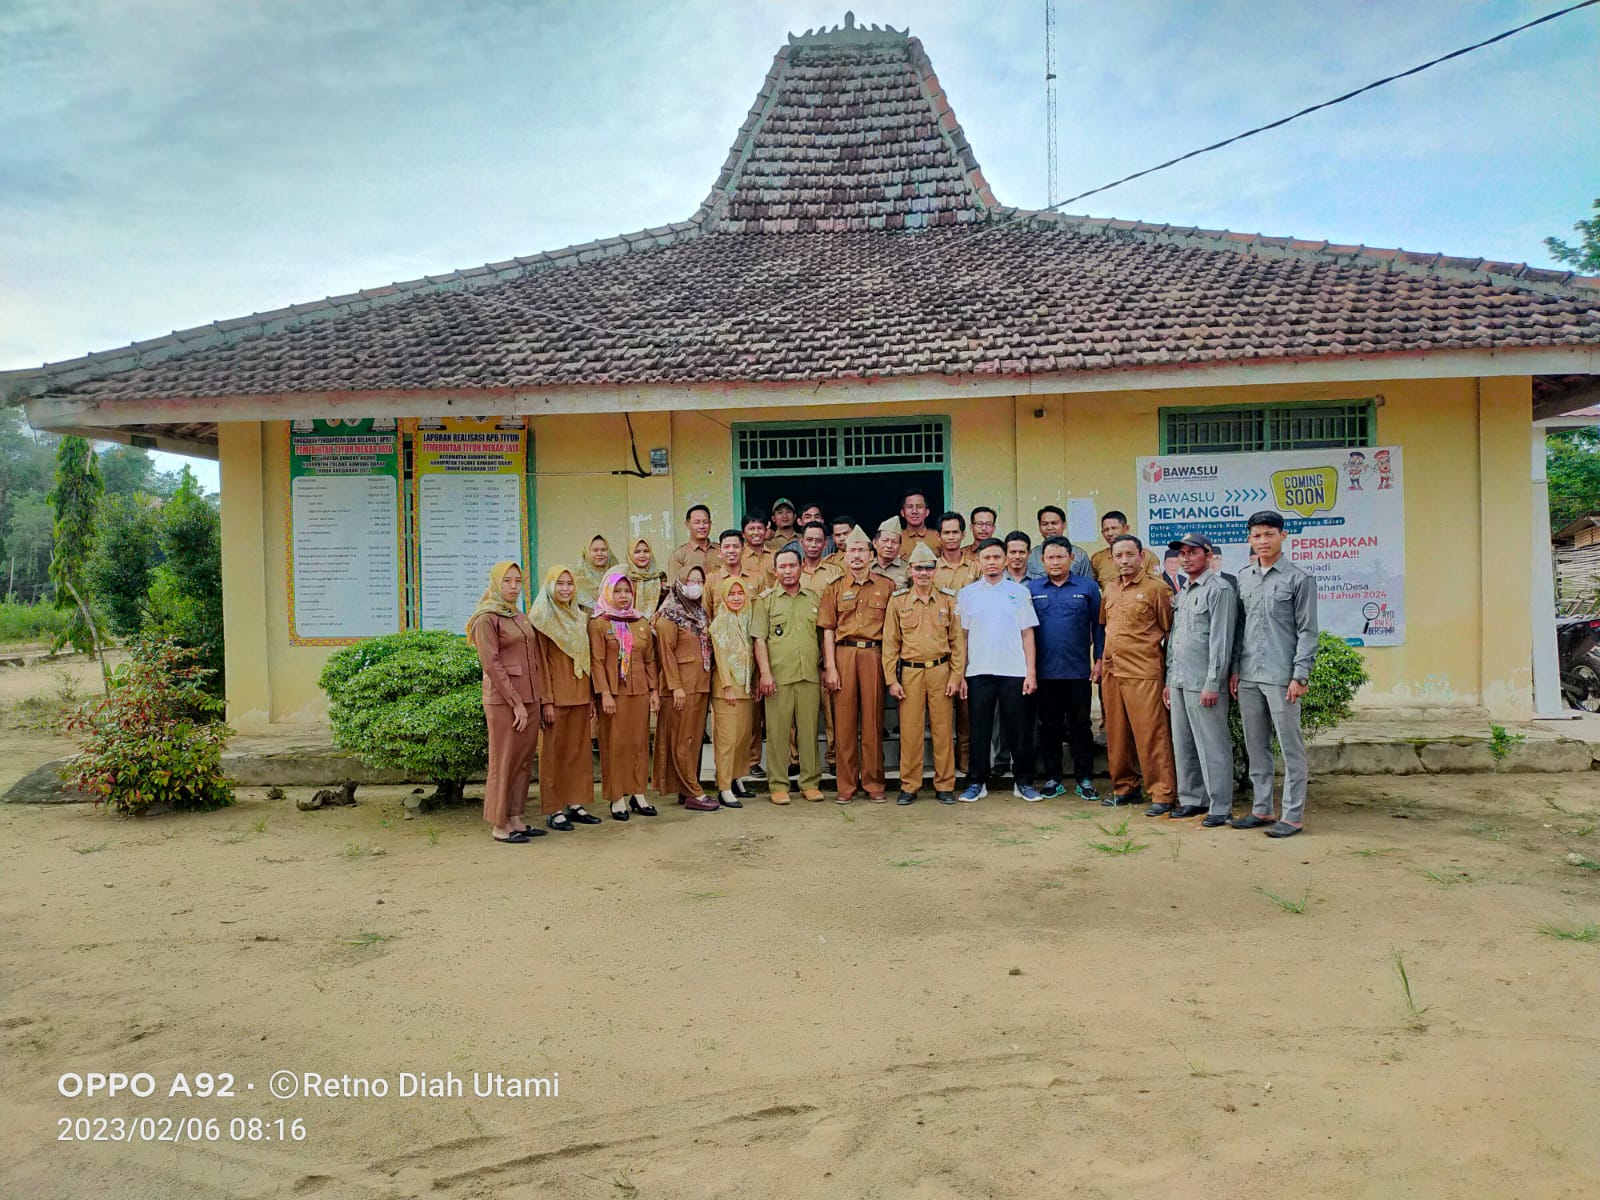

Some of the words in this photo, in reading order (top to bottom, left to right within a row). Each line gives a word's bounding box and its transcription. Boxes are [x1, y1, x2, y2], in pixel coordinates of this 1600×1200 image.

[424, 433, 452, 442] LAPORAN
[453, 433, 485, 442] REALISASI
[1163, 465, 1218, 477] BAWASLU
[1284, 474, 1323, 489] COMING
[1149, 492, 1215, 503] BAWASLU
[1285, 487, 1325, 506] SOON
[1149, 505, 1245, 520] MEMANGGIL
[1291, 536, 1378, 549] PERSIAPKAN
[1291, 551, 1313, 561] DIRI
[1316, 550, 1360, 559] ANDA!!!
[1304, 563, 1331, 573] njadi
[1316, 582, 1369, 591] ahan/Desa
[1329, 591, 1361, 599] Tahun
[1363, 590, 1387, 599] 2024
